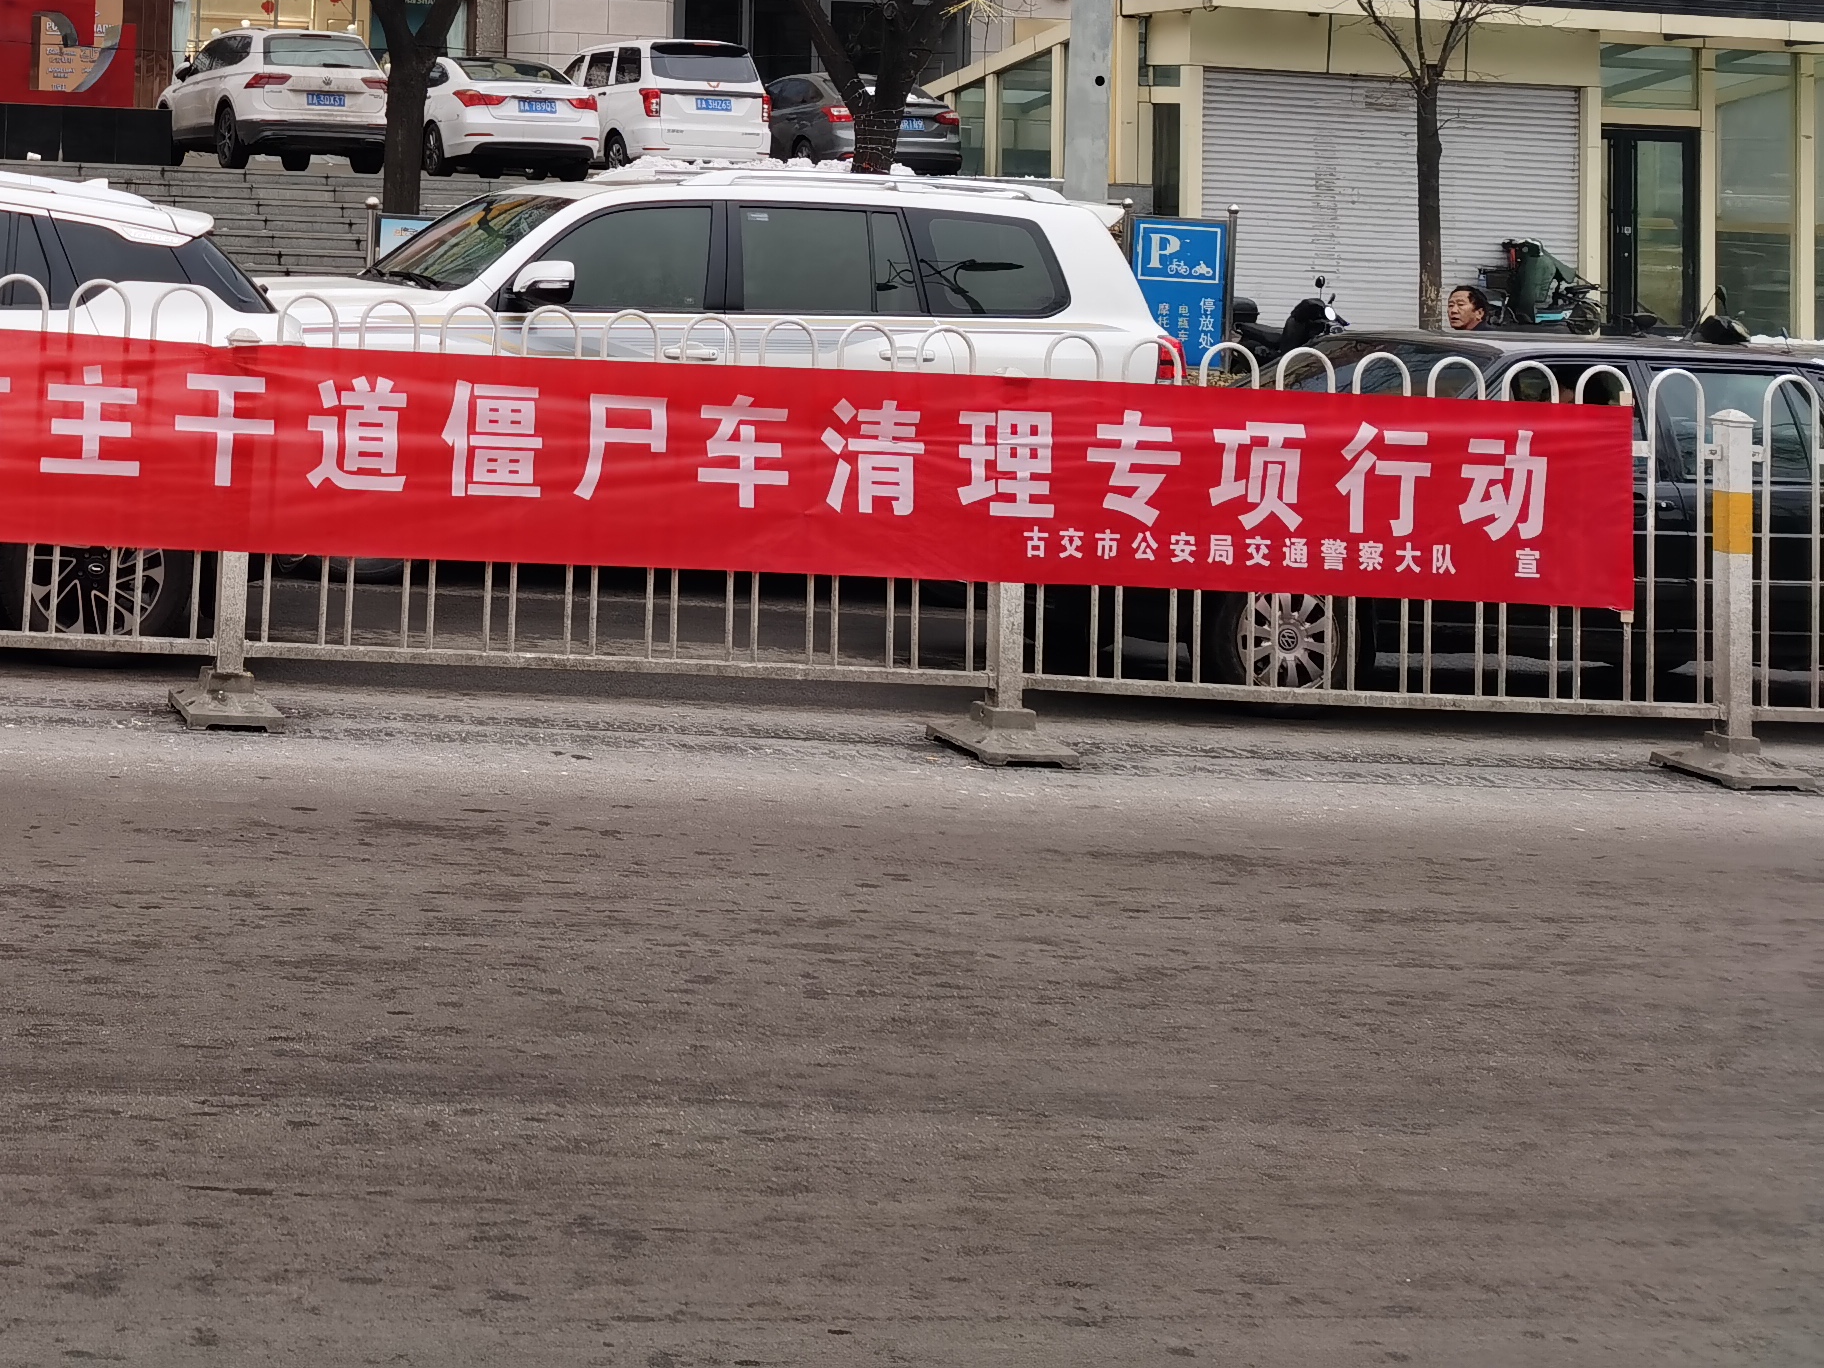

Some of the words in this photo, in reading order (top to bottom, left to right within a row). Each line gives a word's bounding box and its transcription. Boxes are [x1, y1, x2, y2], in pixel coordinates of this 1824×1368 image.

[1146, 233, 1181, 268] P
[1177, 304, 1190, 342] 电瓶车
[1199, 297, 1216, 349] 停放处
[1023, 526, 1456, 575] 古交市公安局交通警察大队
[1514, 547, 1541, 578] 宣
